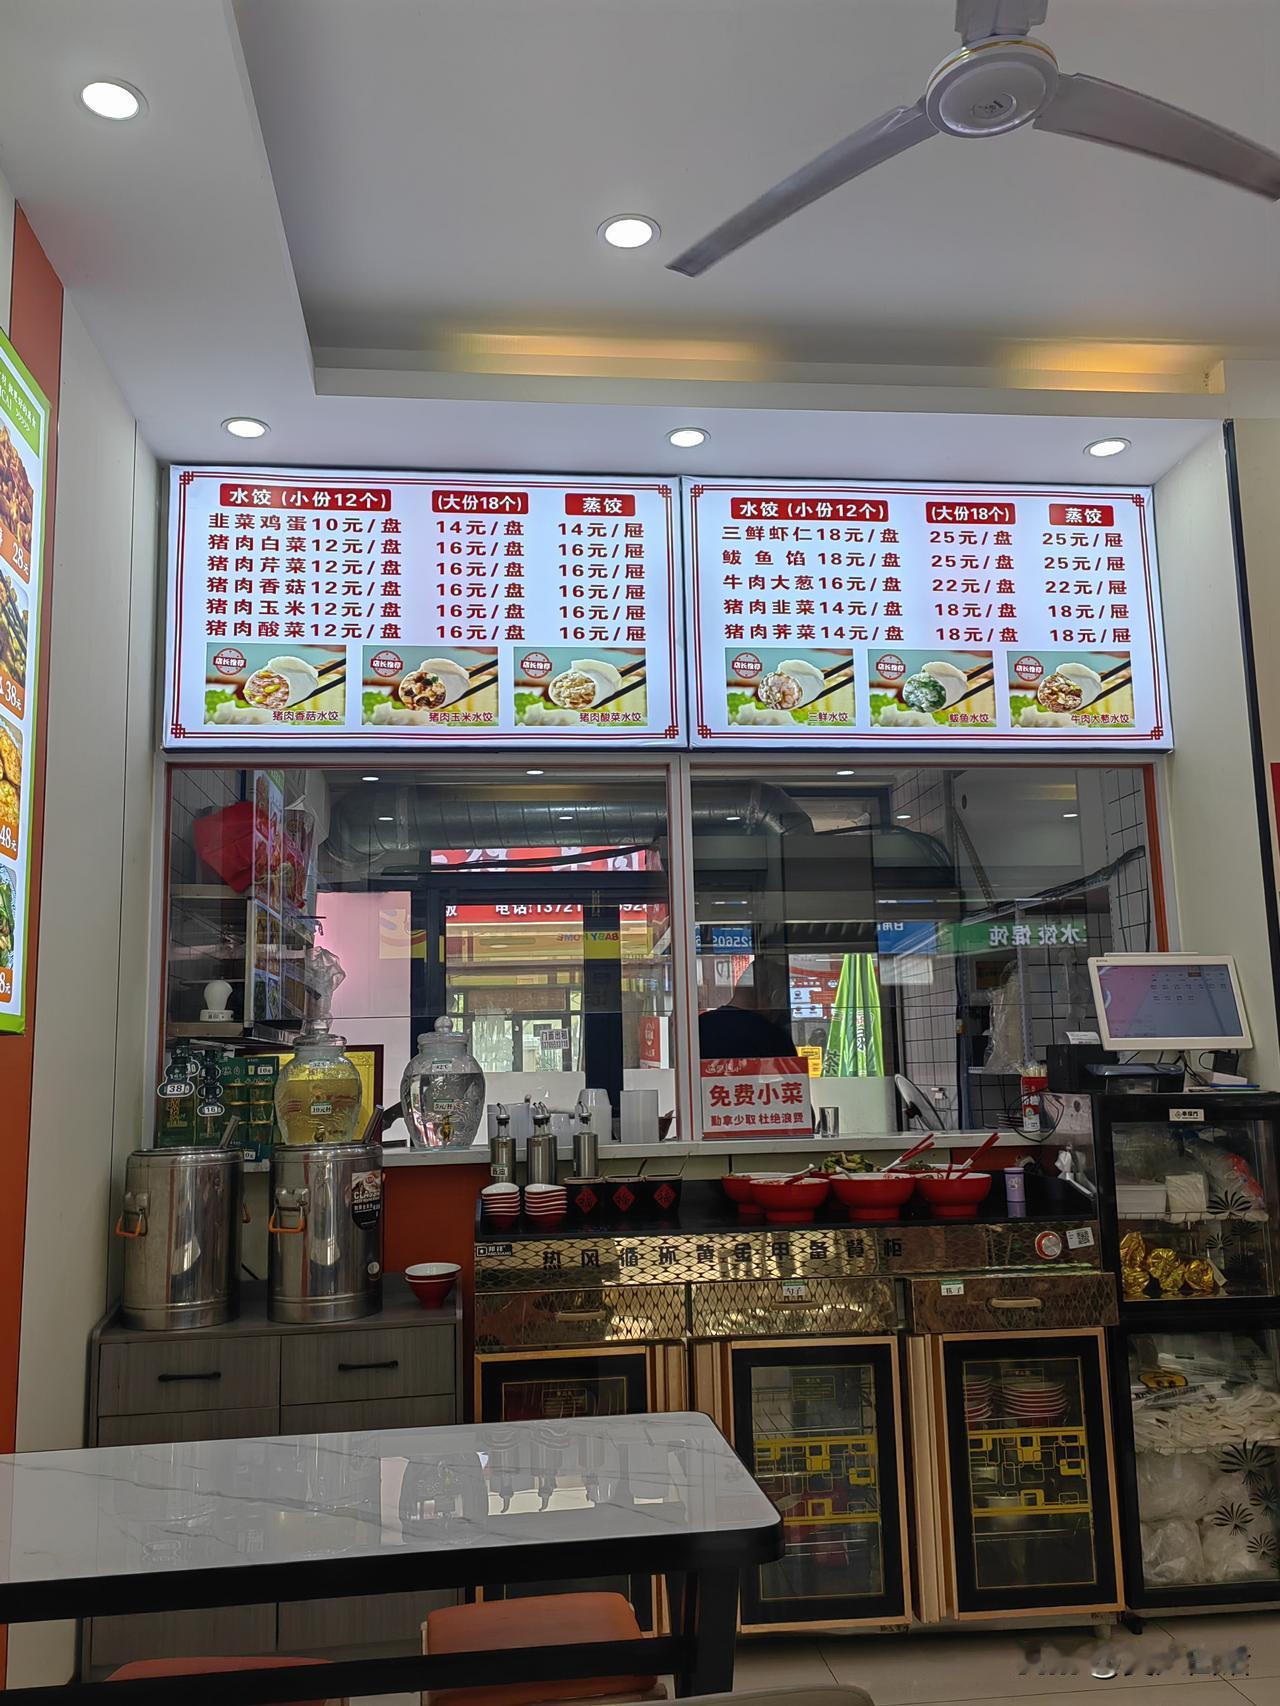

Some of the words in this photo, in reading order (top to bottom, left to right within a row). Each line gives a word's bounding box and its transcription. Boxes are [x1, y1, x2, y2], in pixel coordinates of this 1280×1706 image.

[435, 495, 521, 511] (大份18个)
[583, 497, 622, 513] 蒸饺
[932, 506, 1009, 521] (大份18个)
[1065, 508, 1101, 523] 蒸饺
[437, 520, 524, 535] 14元/盘
[559, 523, 644, 537] 14元/屉
[930, 531, 1012, 545] 25元/盘
[1043, 533, 1123, 547] 25元/屉
[437, 541, 524, 556] 16元/盘
[559, 544, 644, 558] 16元/屉
[12, 542, 29, 577] 28元
[932, 555, 1014, 569] 25元/盘
[1045, 557, 1125, 571] 25元/屉
[437, 562, 524, 577] 16元/盘
[559, 564, 645, 579] 16元/屉
[437, 583, 525, 598] 16元/盘
[559, 585, 645, 599] 16元/屉
[933, 579, 1015, 593] 22元/盘
[1046, 581, 1127, 595] 22元/屉
[437, 604, 525, 619] 16元/盘
[560, 605, 646, 620] 16元/屉
[935, 603, 1017, 618] 18元/盘
[1049, 604, 1129, 618] 18元/屉
[437, 625, 525, 640] 16元/盘
[560, 626, 646, 641] 16元/屉
[936, 627, 1018, 642] 18元/盘
[1050, 628, 1131, 643] 18元/屉
[5, 685, 22, 710] 38元
[271, 710, 340, 723] 猪肉香菇水饺
[428, 710, 495, 723] 猪肉玉米水饺
[579, 710, 642, 723] 猪肉酸菜水饺
[807, 711, 849, 724] 三鲜水饺
[949, 712, 989, 724] 鲅鱼水饺
[1070, 713, 1130, 725] 牛肉大葱水饺
[169, 1085, 182, 1093] 38
[709, 1083, 803, 1107] 免费小菜
